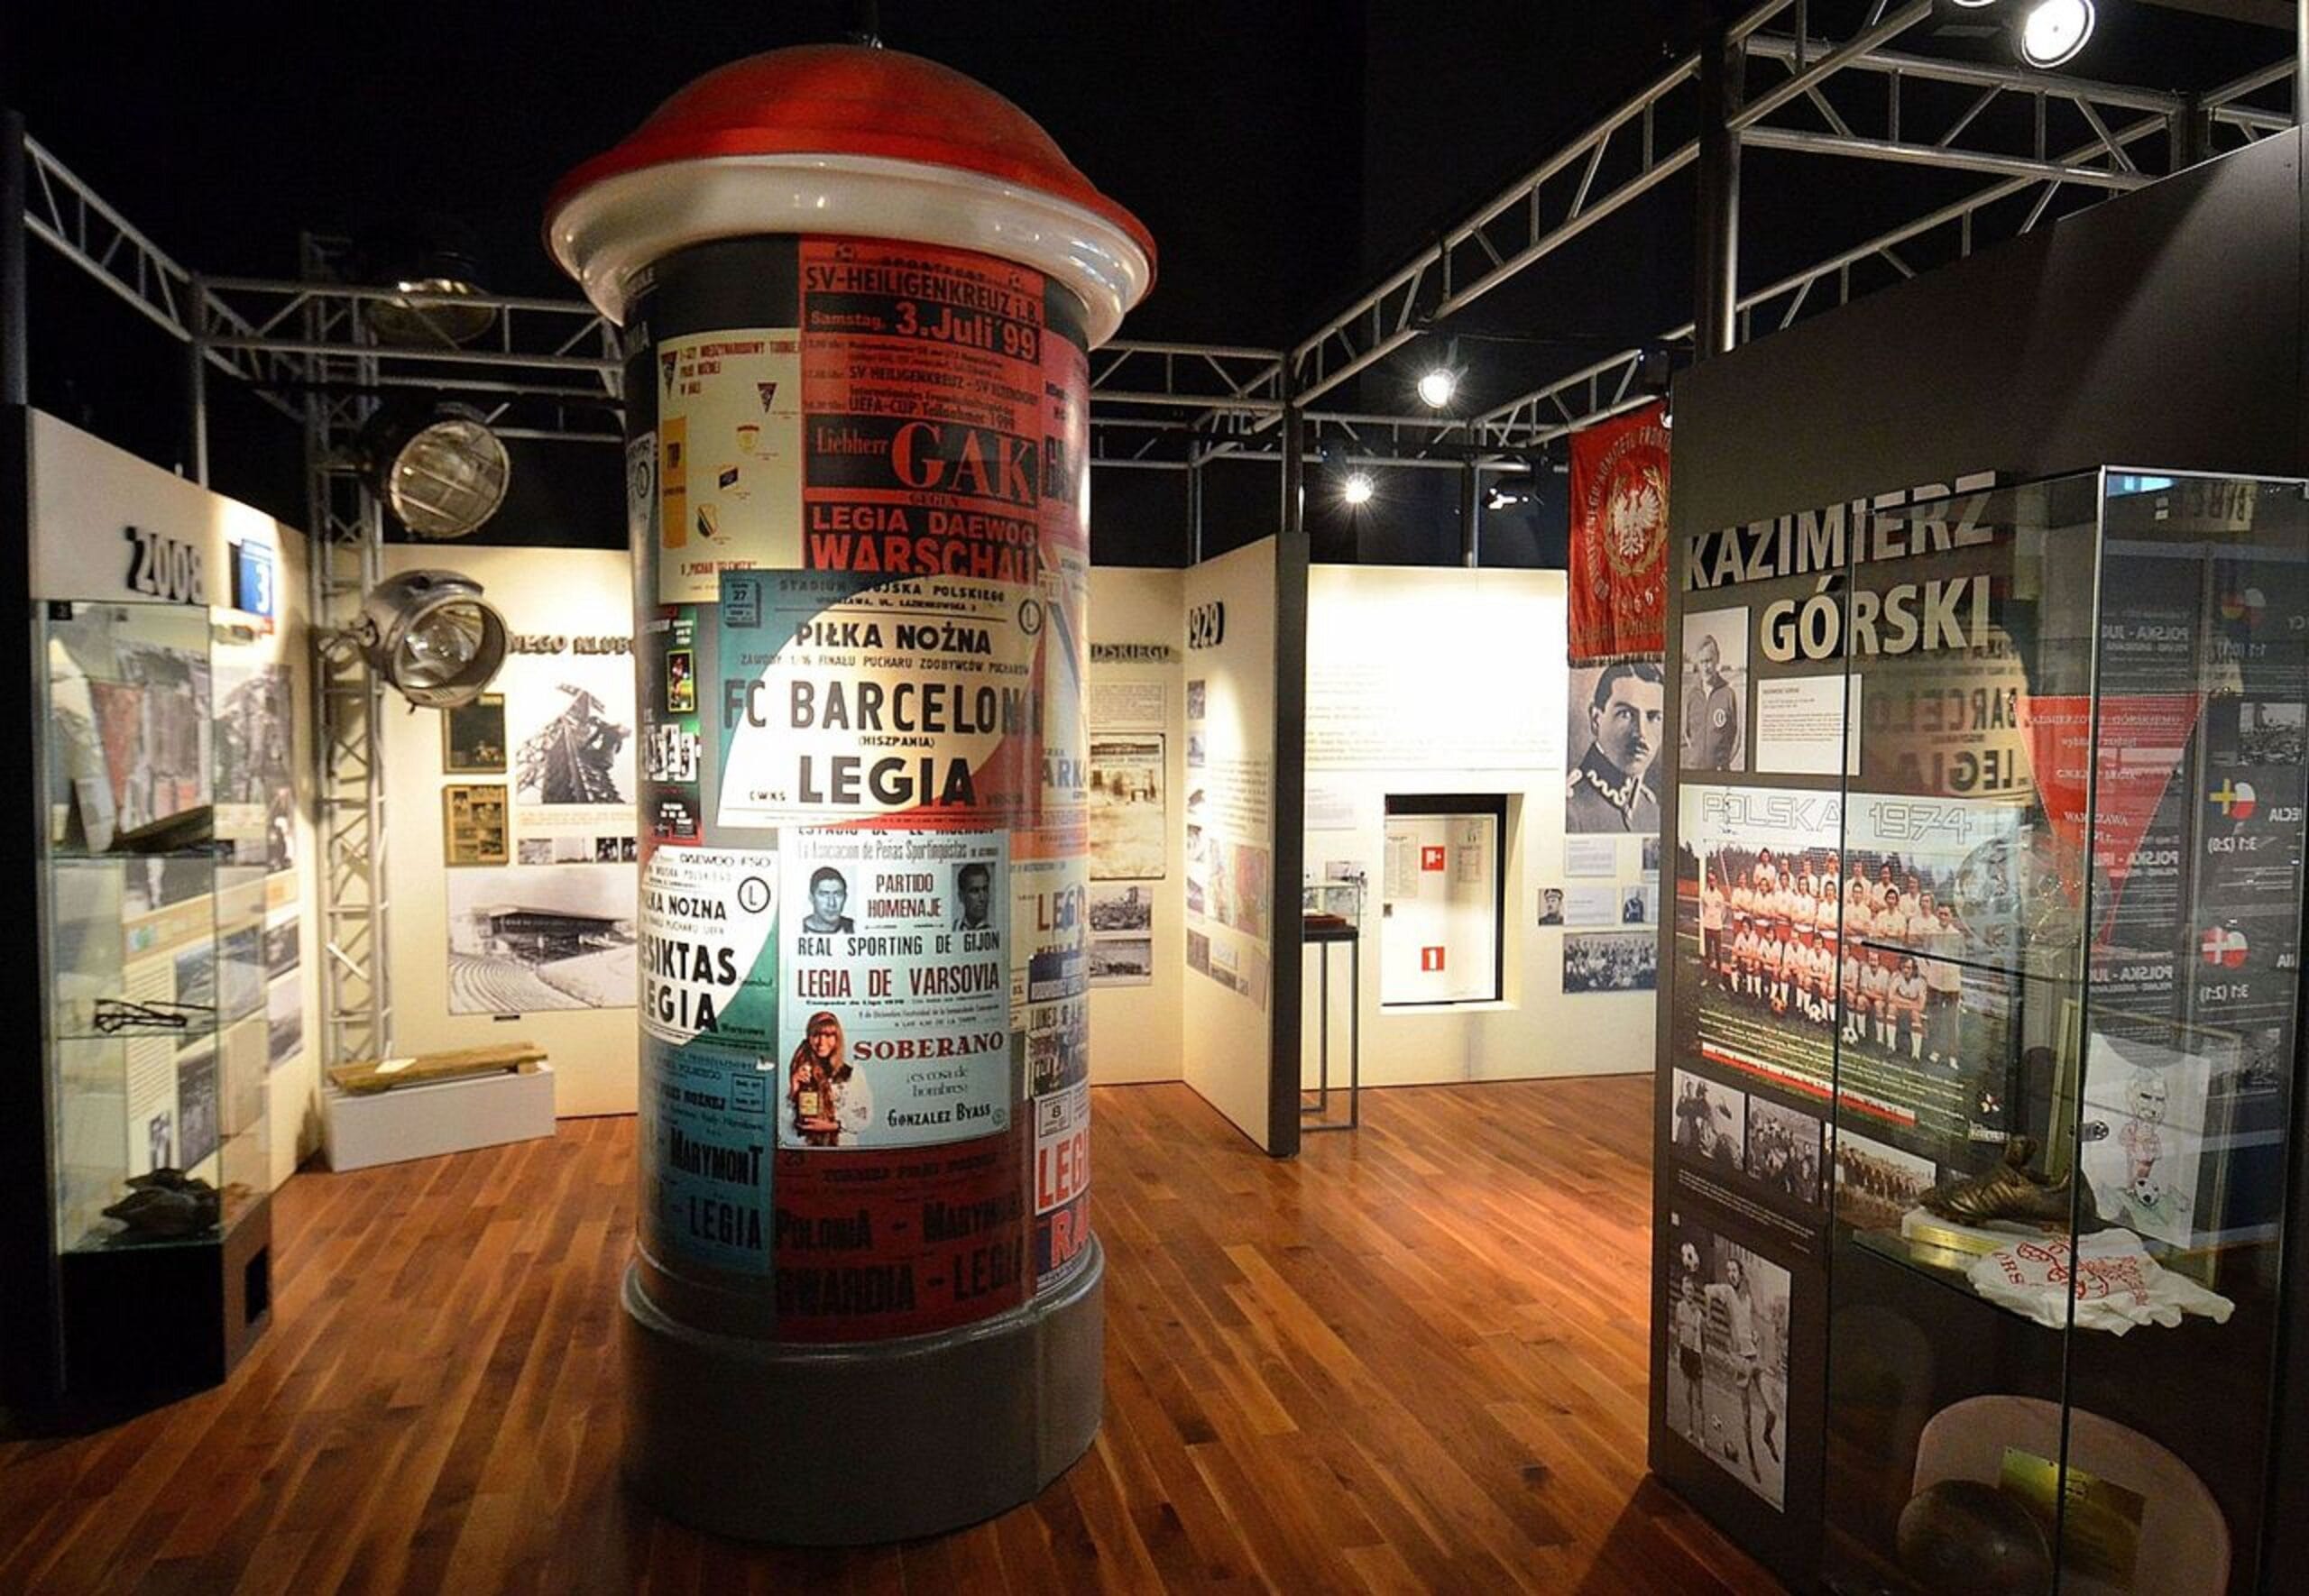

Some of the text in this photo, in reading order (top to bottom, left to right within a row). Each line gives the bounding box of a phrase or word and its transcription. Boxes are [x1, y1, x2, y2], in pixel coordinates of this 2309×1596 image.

[891, 421, 1035, 507] GAK
[813, 506, 1036, 547] LEGIA DAEWOO
[1682, 470, 1996, 592] KAZIMIERZ
[126, 527, 204, 605] 2008
[796, 619, 992, 656] PIŁKA NOŻNA
[1761, 574, 1992, 663] GÓRSKI
[723, 678, 768, 731] FC
[858, 735, 936, 749] (HISZPANIA)
[798, 755, 978, 807] LEGIA
[1868, 802, 1973, 845] 1974
[876, 873, 934, 894] PARTIDO
[867, 898, 942, 919] HOMENAJE
[797, 935, 833, 957] REAL
[847, 934, 923, 956] SPORTING
[935, 932, 952, 954] DE
[797, 968, 852, 998] LEGIA
[869, 967, 893, 998] DE
[909, 962, 1000, 996] VARSOVIA
[852, 1031, 1005, 1061] SOBERANO
[887, 1102, 991, 1128] GONZALEZ BYASS
[689, 1194, 764, 1252] LEGIA
